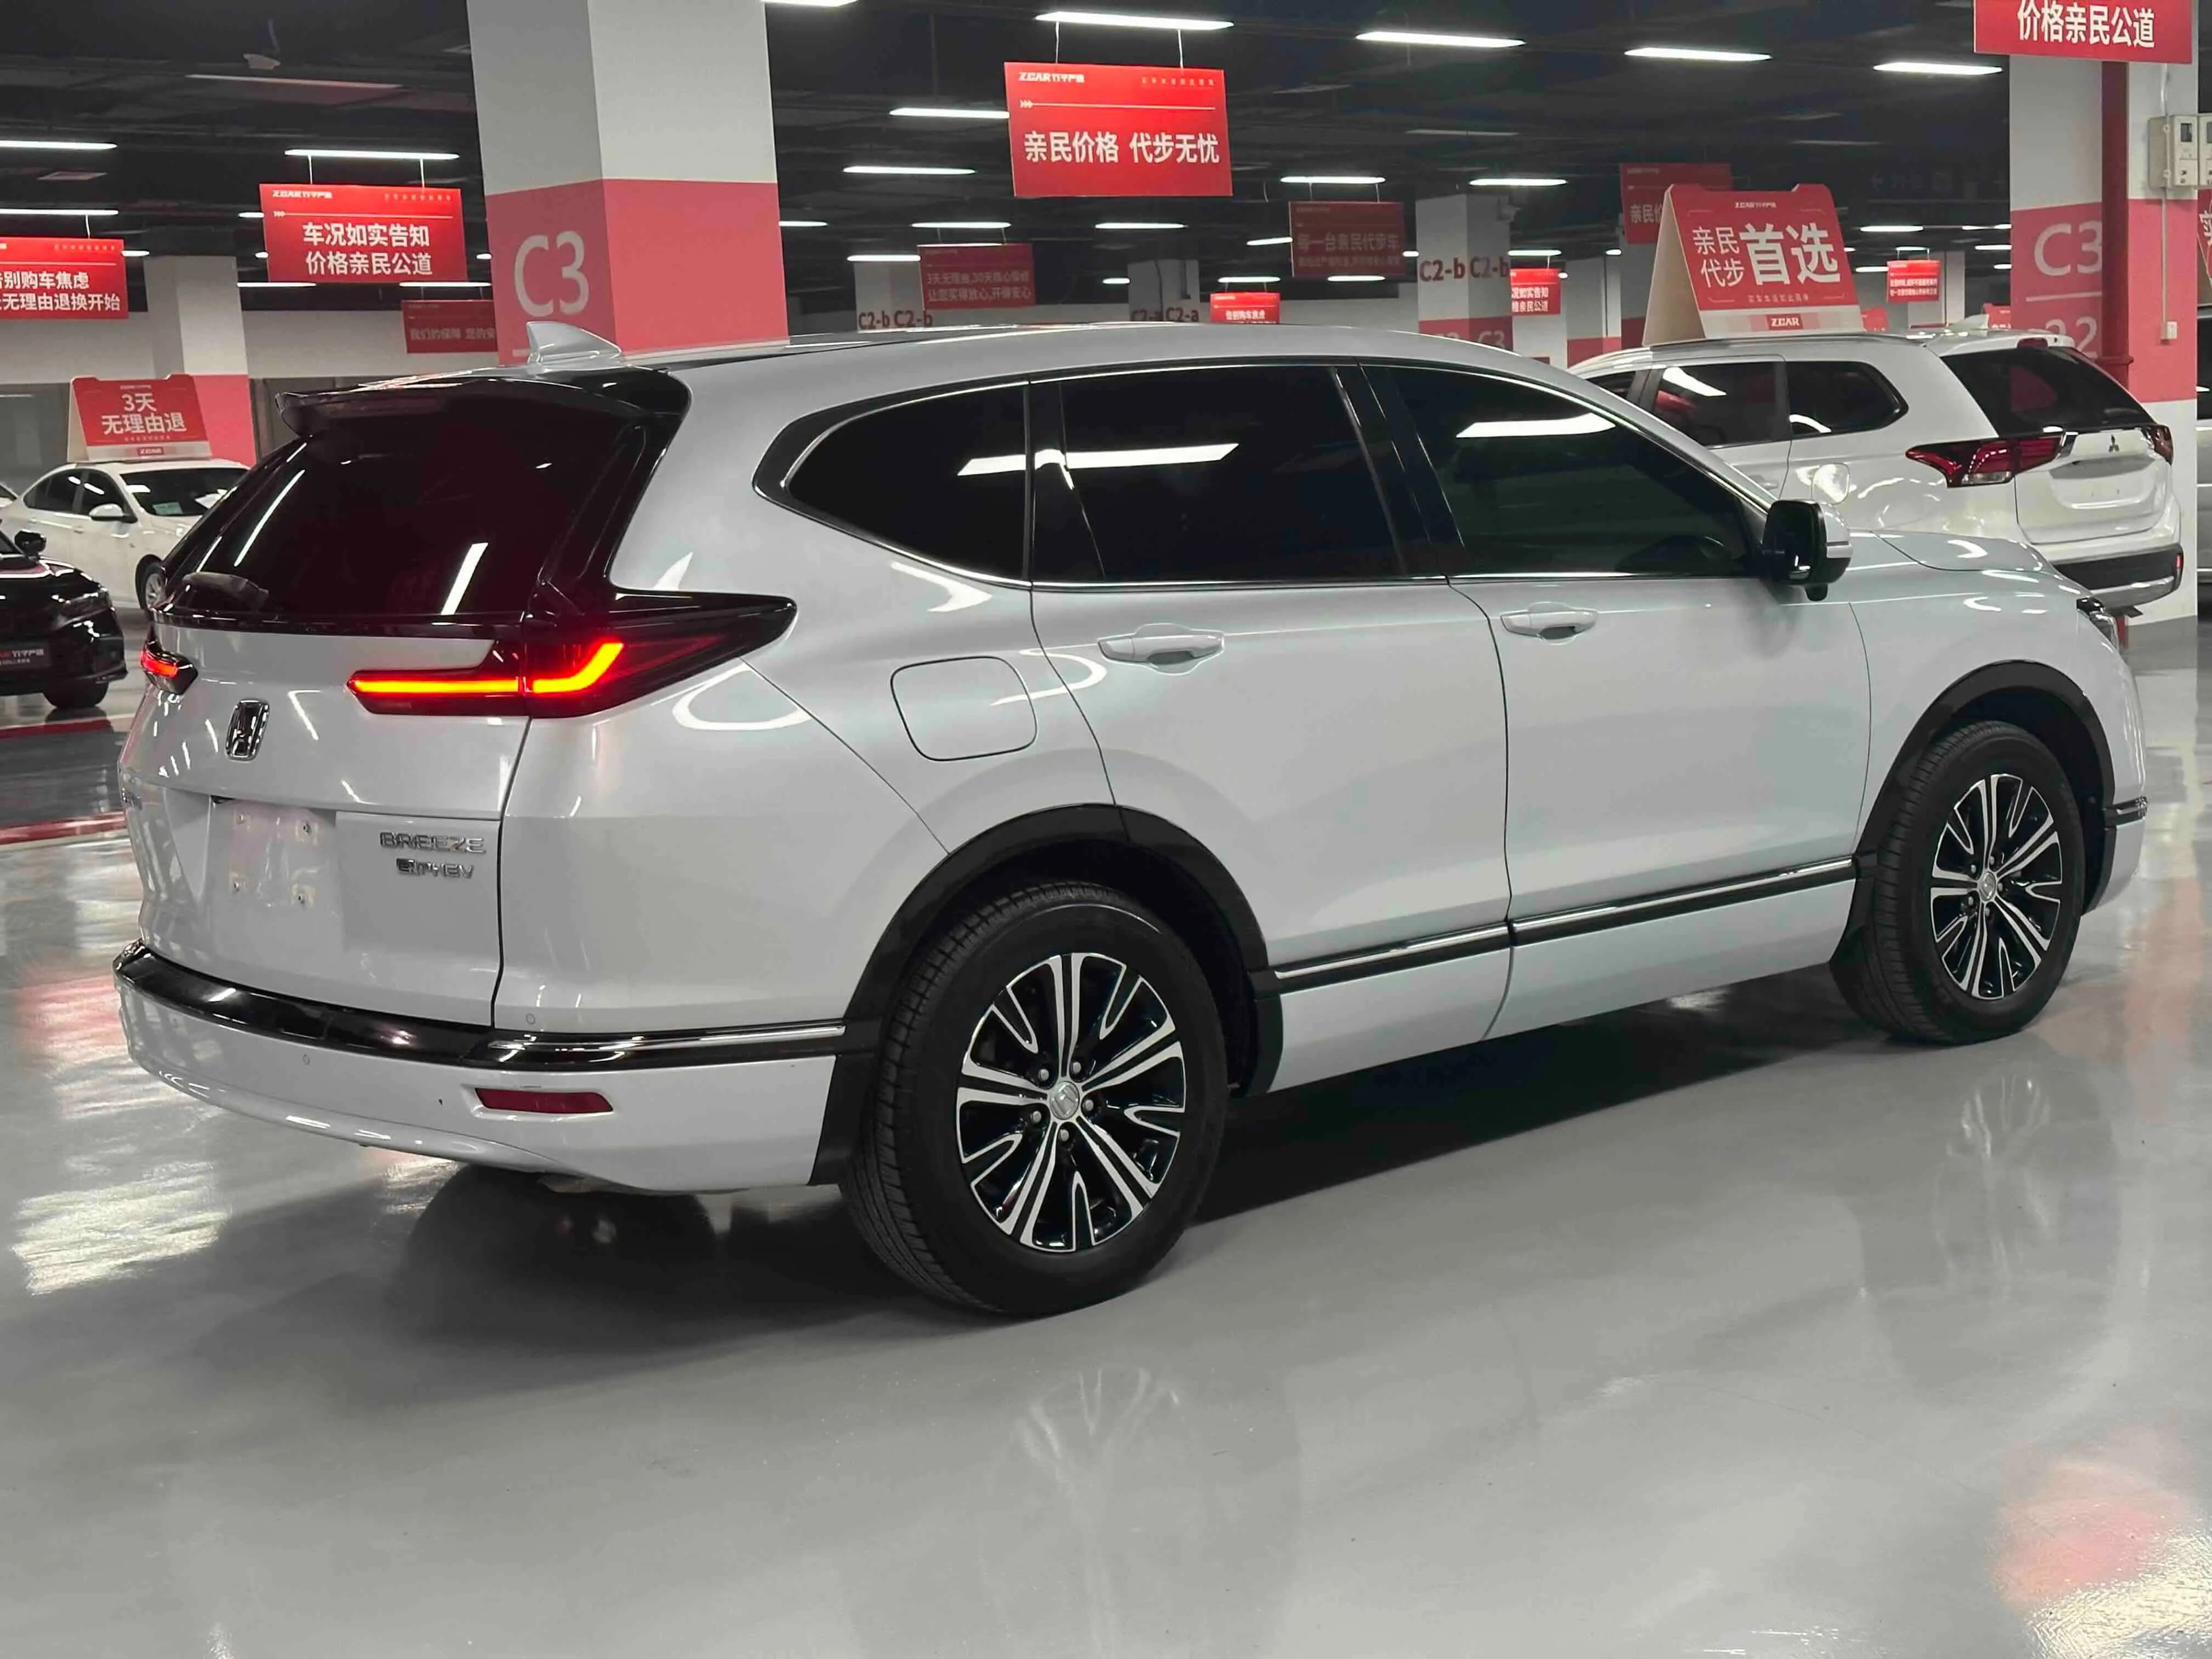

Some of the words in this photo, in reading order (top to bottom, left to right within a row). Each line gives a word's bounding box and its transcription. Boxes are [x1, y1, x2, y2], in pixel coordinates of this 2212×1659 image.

[2017, 0, 2155, 48] 价格亲民公道
[1018, 72, 1051, 82] ZCAR
[1024, 130, 1119, 163] 亲民价格
[1129, 132, 1219, 163] 代步无忧
[302, 222, 430, 248] 车况如实告知
[1692, 226, 1740, 255] 亲民
[1739, 222, 1840, 286] 首选
[2034, 220, 2103, 276] C3
[305, 251, 433, 275] 价格亲民公道
[514, 230, 590, 317] C3
[1419, 258, 1466, 282] C2-b
[1469, 256, 1510, 278] C2-b
[1701, 258, 1745, 288] 代步
[0, 271, 89, 289] 别购车焦虑
[0, 292, 120, 311] 无理由退换开始
[858, 310, 890, 329] C2-b
[894, 309, 933, 328] C2-b
[1165, 307, 1199, 323] C2-a
[1771, 317, 1800, 327] ZCAR
[122, 393, 157, 412] 3天
[101, 412, 187, 435] 无理由退
[380, 832, 486, 854] BREEZE
